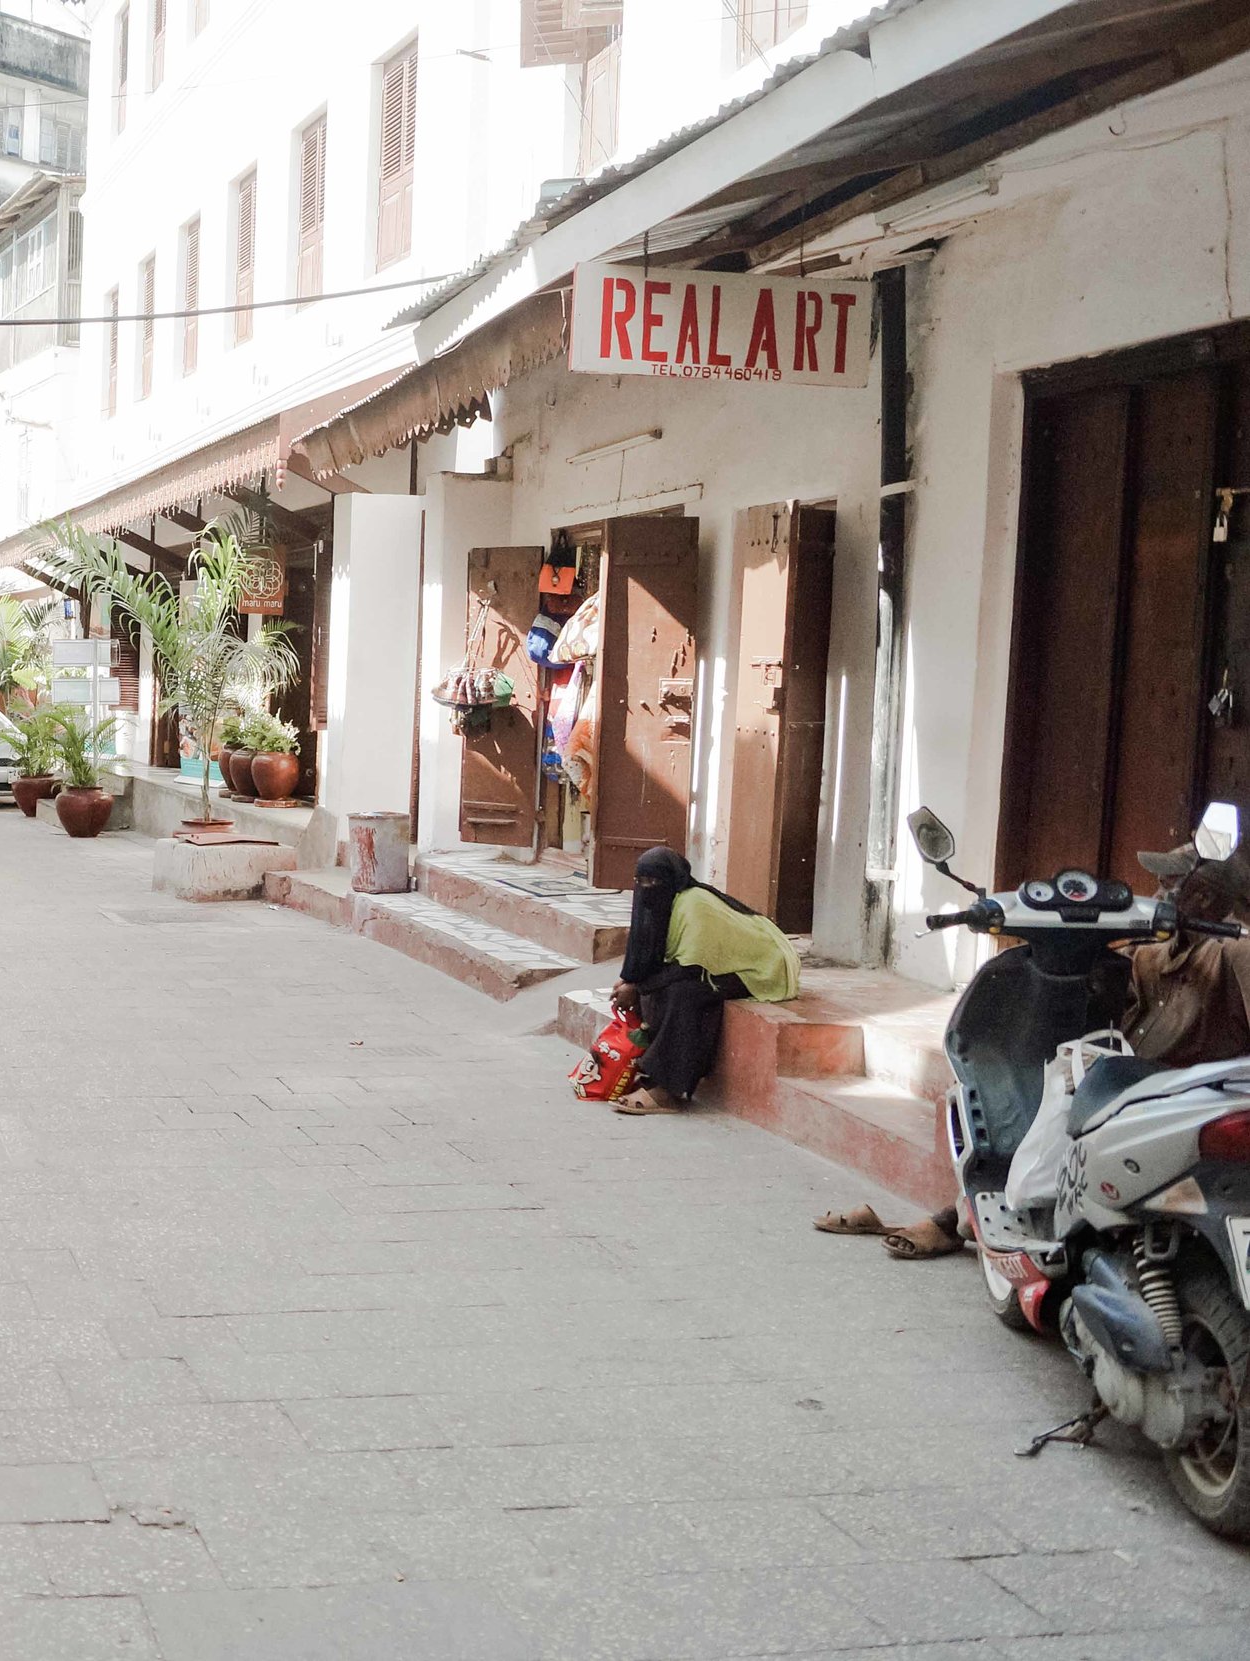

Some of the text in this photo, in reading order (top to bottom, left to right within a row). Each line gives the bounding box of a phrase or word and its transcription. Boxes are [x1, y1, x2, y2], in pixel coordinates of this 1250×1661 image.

[600, 277, 856, 373] REAL ART
[263, 600, 282, 608] maru
